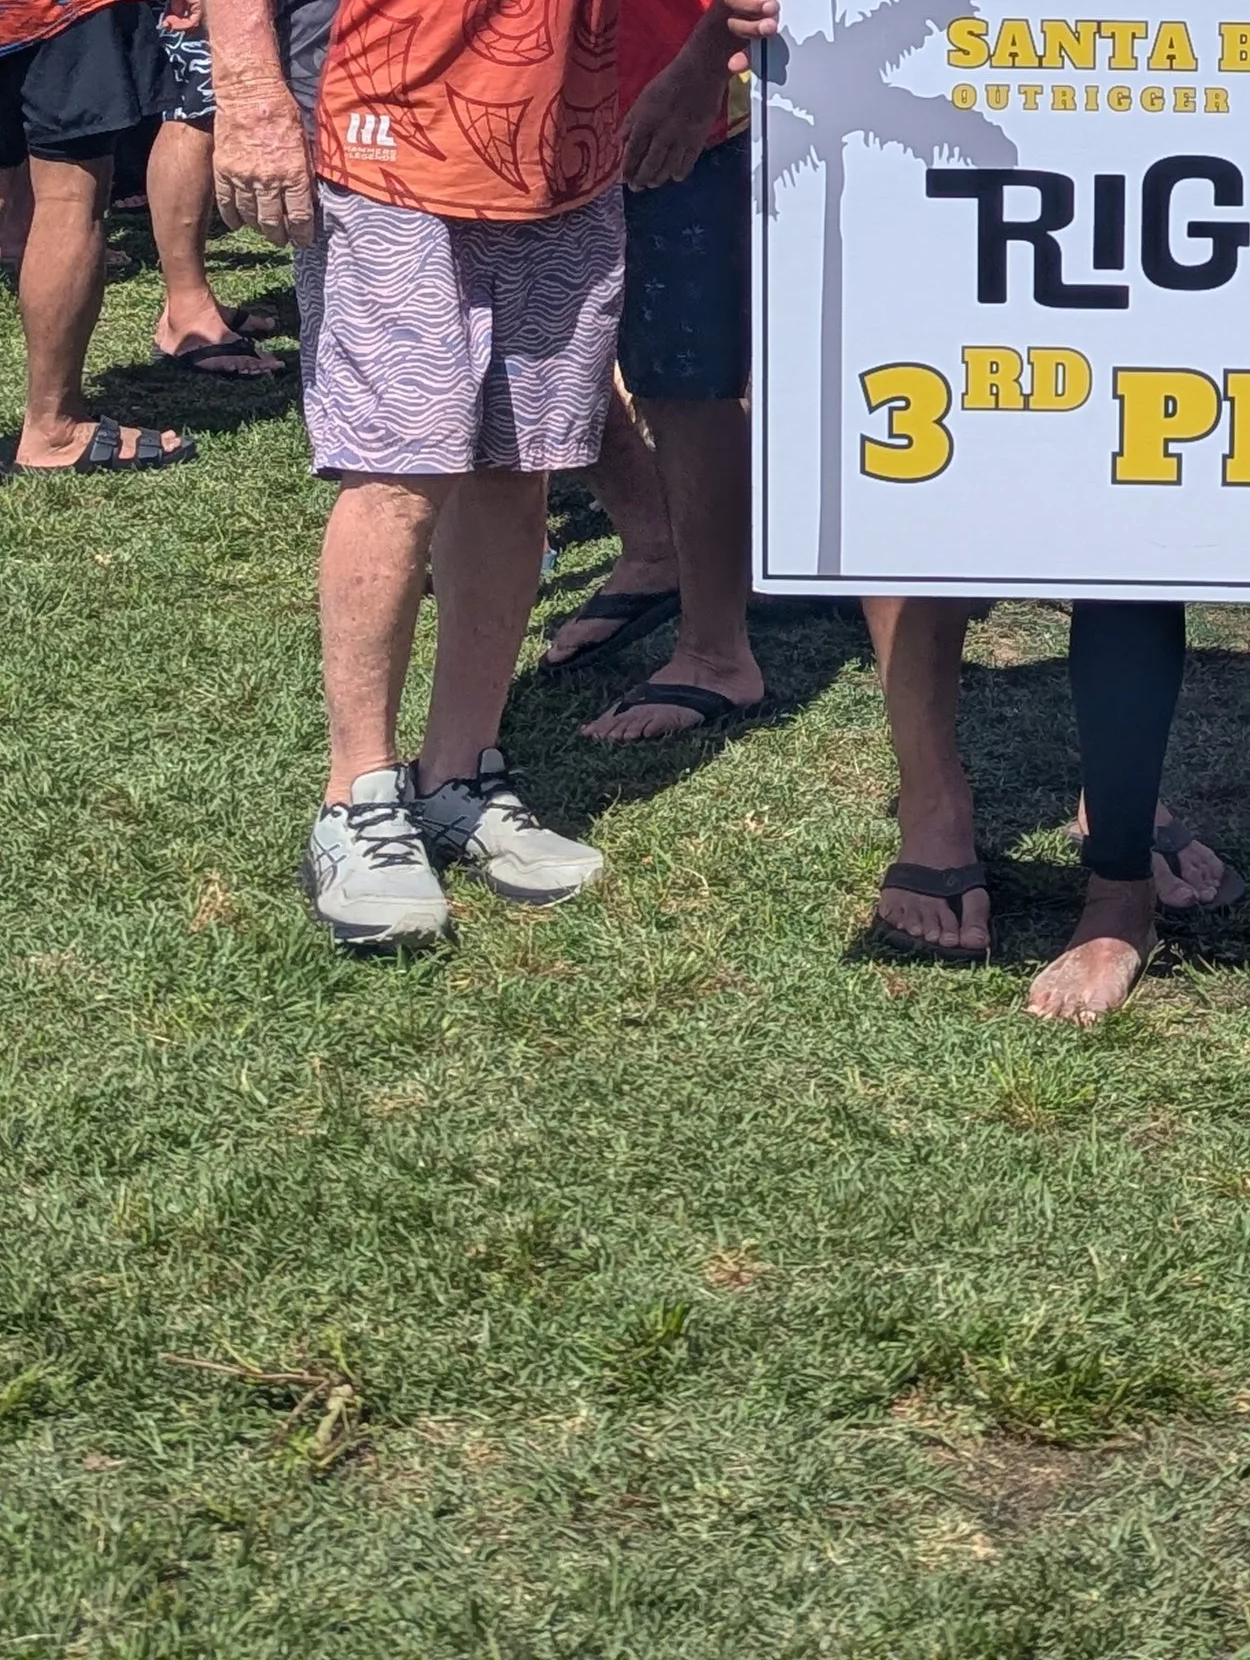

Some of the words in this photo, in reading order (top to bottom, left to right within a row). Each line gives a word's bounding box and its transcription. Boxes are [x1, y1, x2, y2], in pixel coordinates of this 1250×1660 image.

[947, 17, 1198, 71] SANTA
[951, 83, 1230, 114] OUTRIGGER
[925, 155, 1250, 309] RIG
[859, 345, 1093, 485] 3RD
